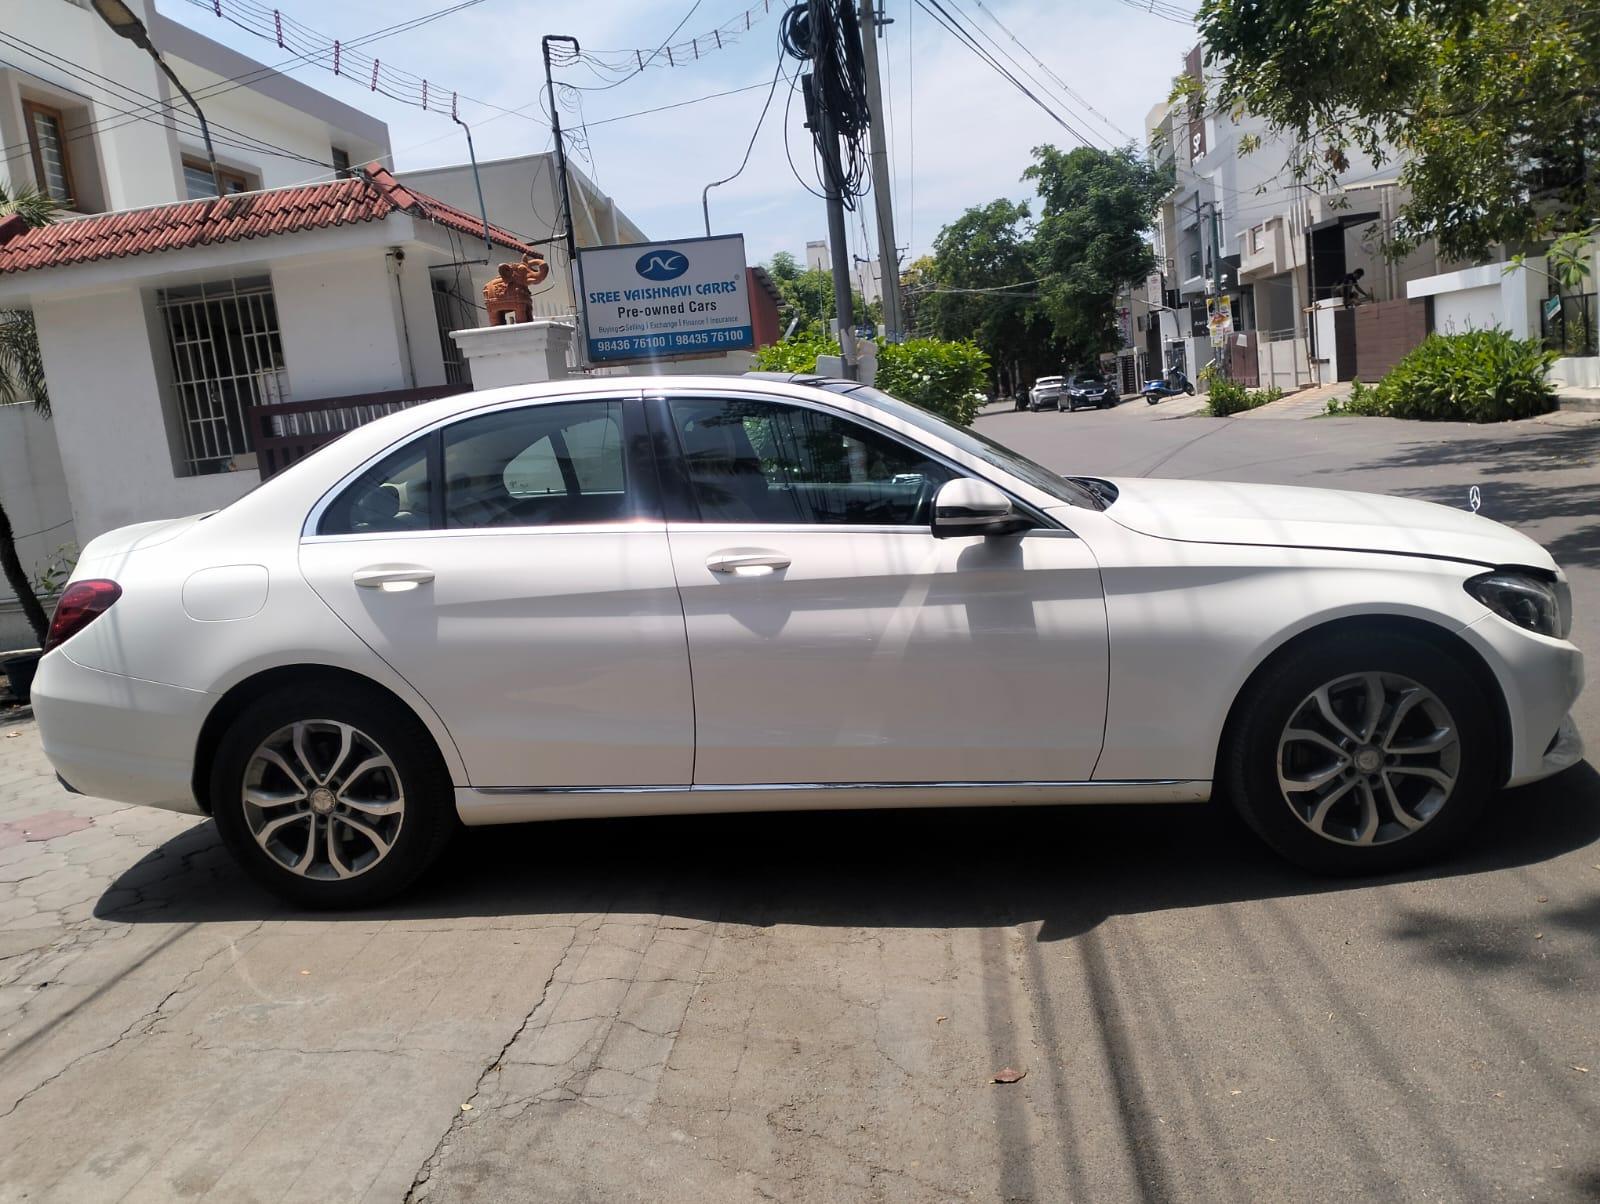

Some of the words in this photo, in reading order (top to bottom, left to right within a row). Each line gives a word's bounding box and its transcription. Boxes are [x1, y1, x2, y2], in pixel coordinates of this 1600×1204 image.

[589, 290, 621, 304] SREE
[624, 285, 692, 301] VAISHNAVI
[696, 281, 737, 295] CARRS
[618, 302, 685, 318] Pre-owned
[689, 300, 717, 313] Cars
[598, 325, 619, 334] Buying
[625, 323, 646, 332] Selling
[650, 320, 678, 330] Exchange
[682, 318, 705, 326] Finance
[710, 315, 738, 323] Insurance
[597, 339, 631, 352] 98436
[634, 336, 666, 349] 76100
[675, 333, 709, 346] 98435
[711, 329, 744, 341] 76100
